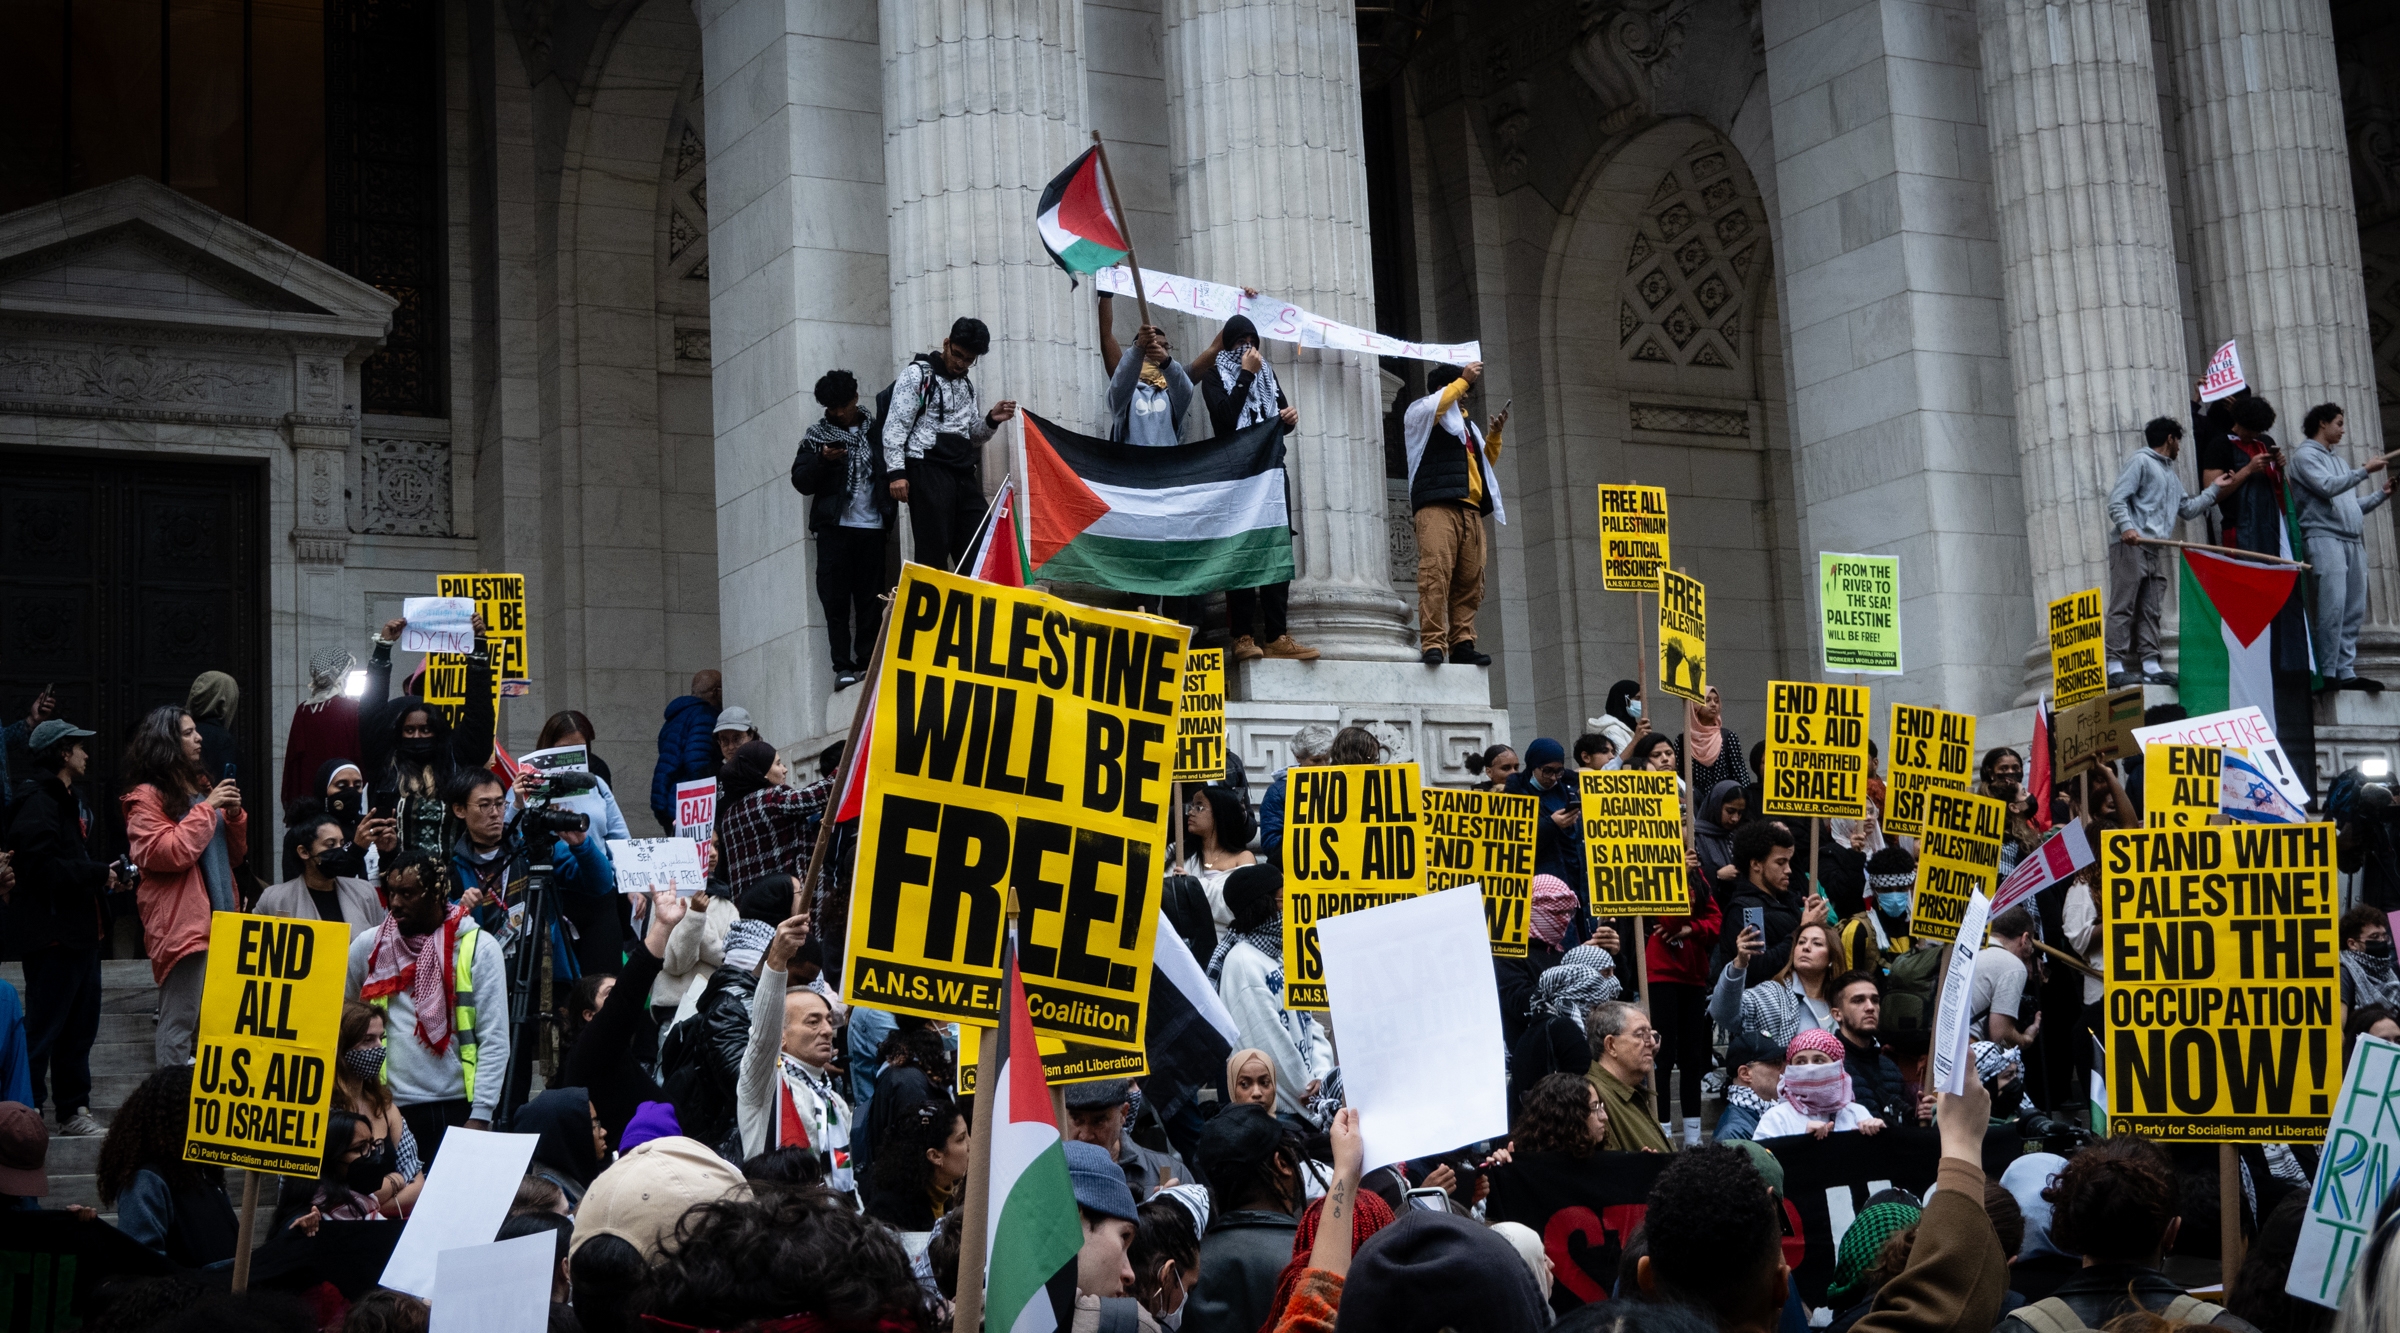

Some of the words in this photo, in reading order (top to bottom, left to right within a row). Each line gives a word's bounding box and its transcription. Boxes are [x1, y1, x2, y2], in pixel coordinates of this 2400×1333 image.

[2208, 364, 2220, 374] ILL
[1602, 490, 1637, 513] FREE
[1641, 492, 1665, 515] ALL
[1602, 516, 1666, 535] PALESTINIAN
[1609, 540, 1662, 559] POLITICAL
[1607, 580, 1642, 588] A.N.S.W.E.R.
[1838, 563, 1867, 577] FROM
[1870, 565, 1890, 578] THE
[441, 578, 523, 601] PALESTINE
[1663, 572, 1703, 621] FREE
[1843, 579, 1872, 593] RIVER
[1875, 581, 1891, 594] TO
[1847, 594, 1866, 607] THE
[1869, 596, 1891, 609] SEA!
[2051, 600, 2074, 631] FREE
[2078, 594, 2100, 621] ALL
[499, 602, 523, 631] BE
[1661, 608, 1705, 642] PALESTINE
[1827, 609, 1891, 628] PALESTINE
[409, 630, 471, 654] DYING
[897, 579, 1180, 716] PALESTINE
[1828, 629, 1845, 640] WILL
[1848, 631, 1859, 641] BE
[1861, 632, 1880, 643] FREE!
[2051, 620, 2101, 651] PALESTINIAN
[2058, 648, 2097, 675] POLITICAL
[2056, 666, 2103, 696] PRISONERS!
[1774, 684, 1817, 714] END
[1824, 687, 1863, 718] ALL
[1774, 715, 1816, 745] U.S.
[1824, 718, 1861, 748] AID
[1896, 707, 1934, 739] END
[1939, 714, 1969, 746] ALL
[2077, 710, 2101, 732] Free
[895, 668, 1064, 802] WILL
[1082, 708, 1165, 824] BE
[1895, 737, 1931, 769] U.S.
[1937, 744, 1966, 774] AID
[2063, 729, 2116, 763] Palestine
[1188, 771, 1198, 779] and
[1199, 770, 1224, 779] Liberation
[1773, 750, 1788, 767] TO
[1792, 751, 1861, 772] APARTHEID
[2169, 746, 2221, 777] END
[1582, 775, 1675, 795] RESISTANCE
[1774, 769, 1857, 802] ISRAEL!
[1893, 771, 1907, 789] TO
[2172, 777, 2219, 808] ALL
[1292, 771, 1348, 825] END
[1360, 768, 1417, 823] ALL
[1422, 790, 1482, 814] STAND
[1488, 794, 1534, 819] WITH
[1600, 797, 1662, 817] AGAINST
[1768, 802, 1820, 812] A.N.S.W.E.R.
[1822, 805, 1860, 814] Coalition
[681, 797, 712, 826] GAZA
[1928, 794, 1972, 833] FREE
[1974, 801, 2000, 840] ALL
[682, 826, 704, 842] WILL
[705, 822, 712, 838] BE
[1424, 813, 1533, 842] PALESTINE!
[1586, 819, 1680, 839] OCCUPATION
[637, 853, 652, 861] SEA
[1293, 827, 1349, 881] U.S.
[1361, 826, 1415, 880] AID
[1426, 837, 1474, 869] END
[1482, 841, 1532, 874] THE
[1592, 844, 1608, 864] IS
[1612, 844, 1623, 864] A
[1626, 844, 1682, 864] HUMAN
[1924, 831, 1999, 868] PALESTINIAN
[2108, 830, 2222, 874] STAND
[2232, 826, 2329, 869] WITH
[621, 869, 652, 888] PALESTINE
[680, 870, 702, 885] FREE!
[867, 793, 1152, 992] FREE!
[1427, 871, 1528, 899] CCUPATION
[1594, 865, 1685, 902] RIGHT!
[1292, 893, 1311, 925] TO
[2110, 871, 2330, 920] PALESTINE!
[1914, 922, 1957, 938] A.N.S.W.E.R.
[236, 920, 315, 980] END
[1494, 945, 1525, 954] Liberation
[2111, 920, 2216, 982] END
[2230, 918, 2335, 979] THE
[234, 979, 298, 1041] ALL
[1027, 993, 1130, 1033] Coalition
[2110, 986, 2332, 1028] OCCUPATION
[200, 1045, 255, 1098] U.S.
[262, 1053, 325, 1105] AID
[1064, 1060, 1083, 1074] and
[1086, 1054, 1142, 1072] Liberation
[2114, 1028, 2329, 1115] NOW!
[194, 1098, 221, 1136] TO
[225, 1101, 320, 1149] ISRAEL!
[2135, 1124, 2165, 1137] Party
[2167, 1124, 2185, 1134] for
[2187, 1124, 2245, 1136] Socialism
[2249, 1124, 2272, 1136] and
[201, 1148, 219, 1160] Party
[220, 1151, 230, 1160] for
[231, 1152, 262, 1166] Socialism
[263, 1157, 278, 1168] and
[279, 1159, 319, 1173] Liberation
